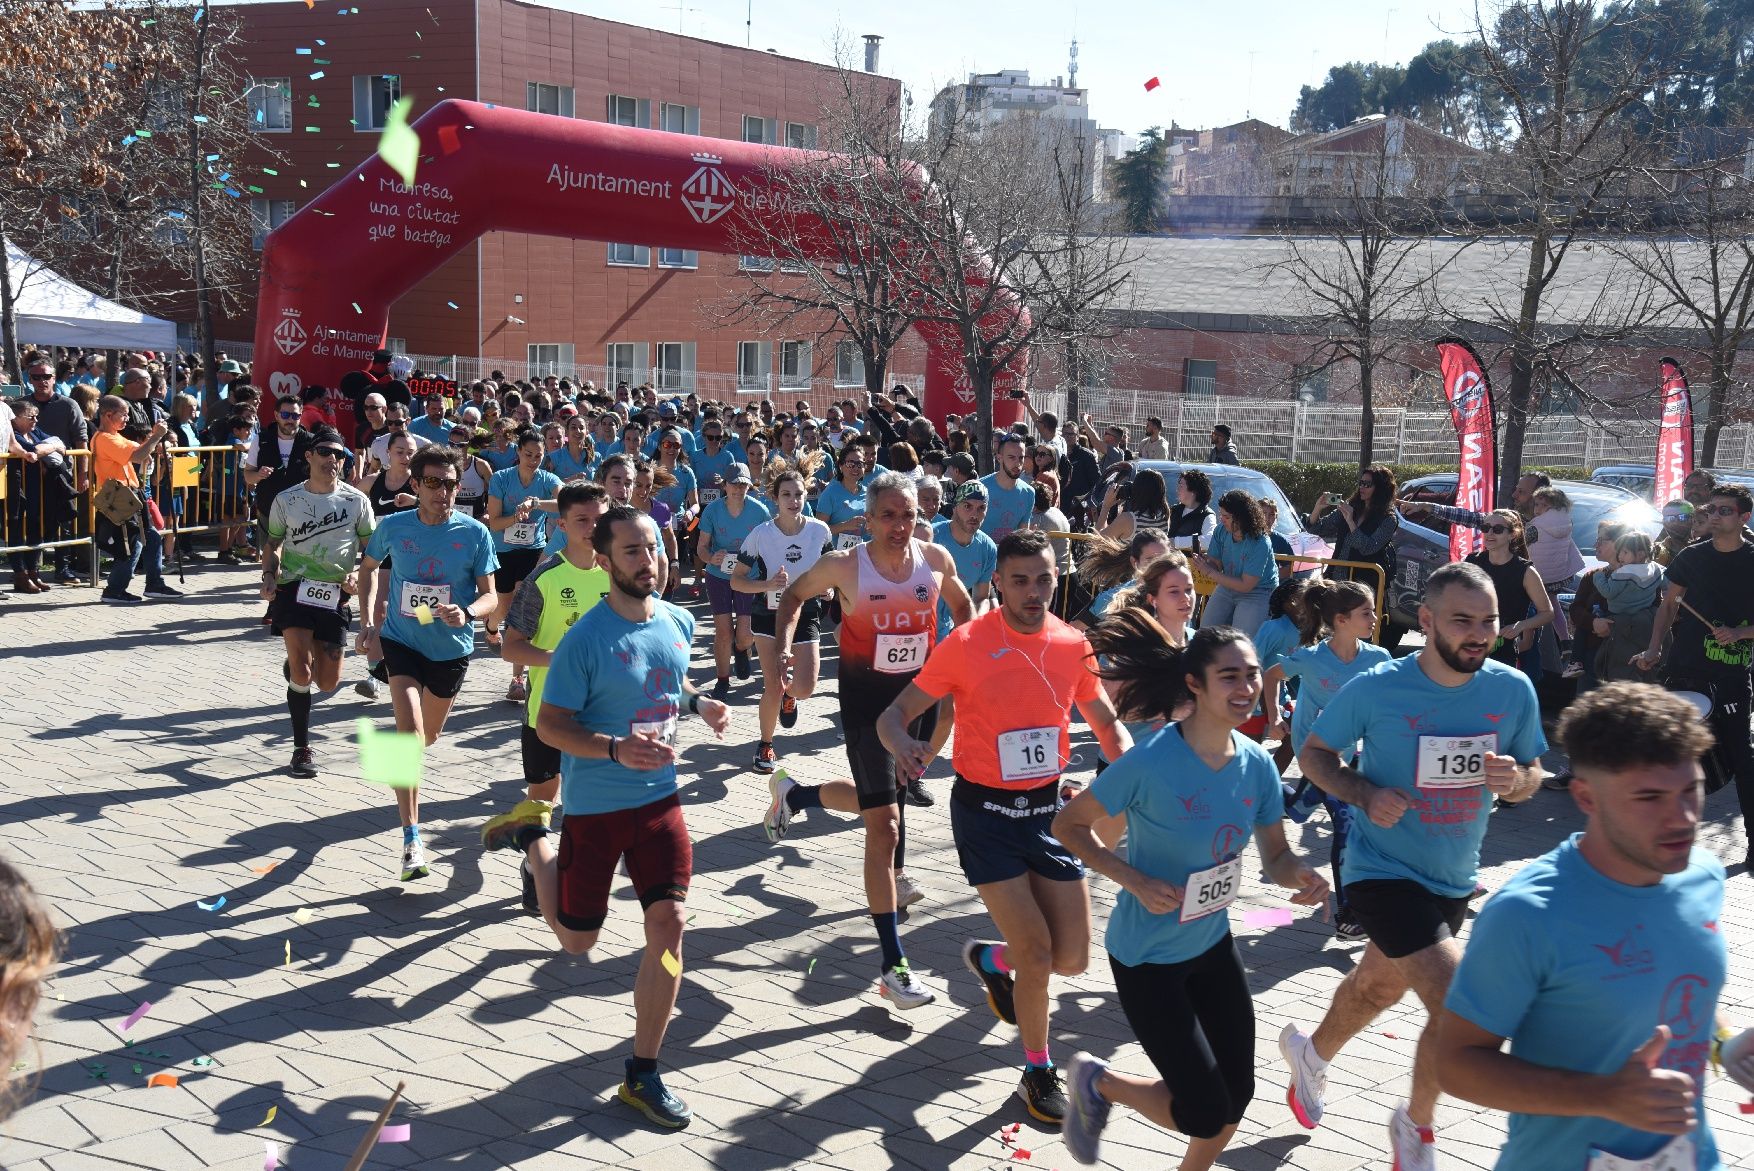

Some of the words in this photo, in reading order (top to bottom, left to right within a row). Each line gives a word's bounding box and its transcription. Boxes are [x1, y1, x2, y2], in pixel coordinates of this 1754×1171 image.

[380, 178, 453, 202] Manresa,
[547, 163, 673, 199] Ajuntament
[744, 188, 768, 210] de
[370, 202, 400, 217] una
[407, 202, 460, 224] ciutat
[369, 224, 396, 242] que
[404, 225, 451, 248] batega
[313, 324, 382, 344] Ajuntament
[312, 342, 329, 356] de
[333, 344, 375, 361] Manres
[409, 378, 456, 397] 00:05
[703, 493, 717, 501] 399
[513, 529, 527, 539] 45
[306, 586, 332, 601] 666
[410, 594, 440, 609] 652
[872, 609, 932, 631] UAT
[887, 647, 917, 664] 621
[1022, 744, 1045, 765] 16
[1437, 753, 1481, 775] 136
[983, 801, 1031, 819] SPHERE
[1033, 804, 1055, 816] PRO
[1197, 875, 1234, 905] 505
